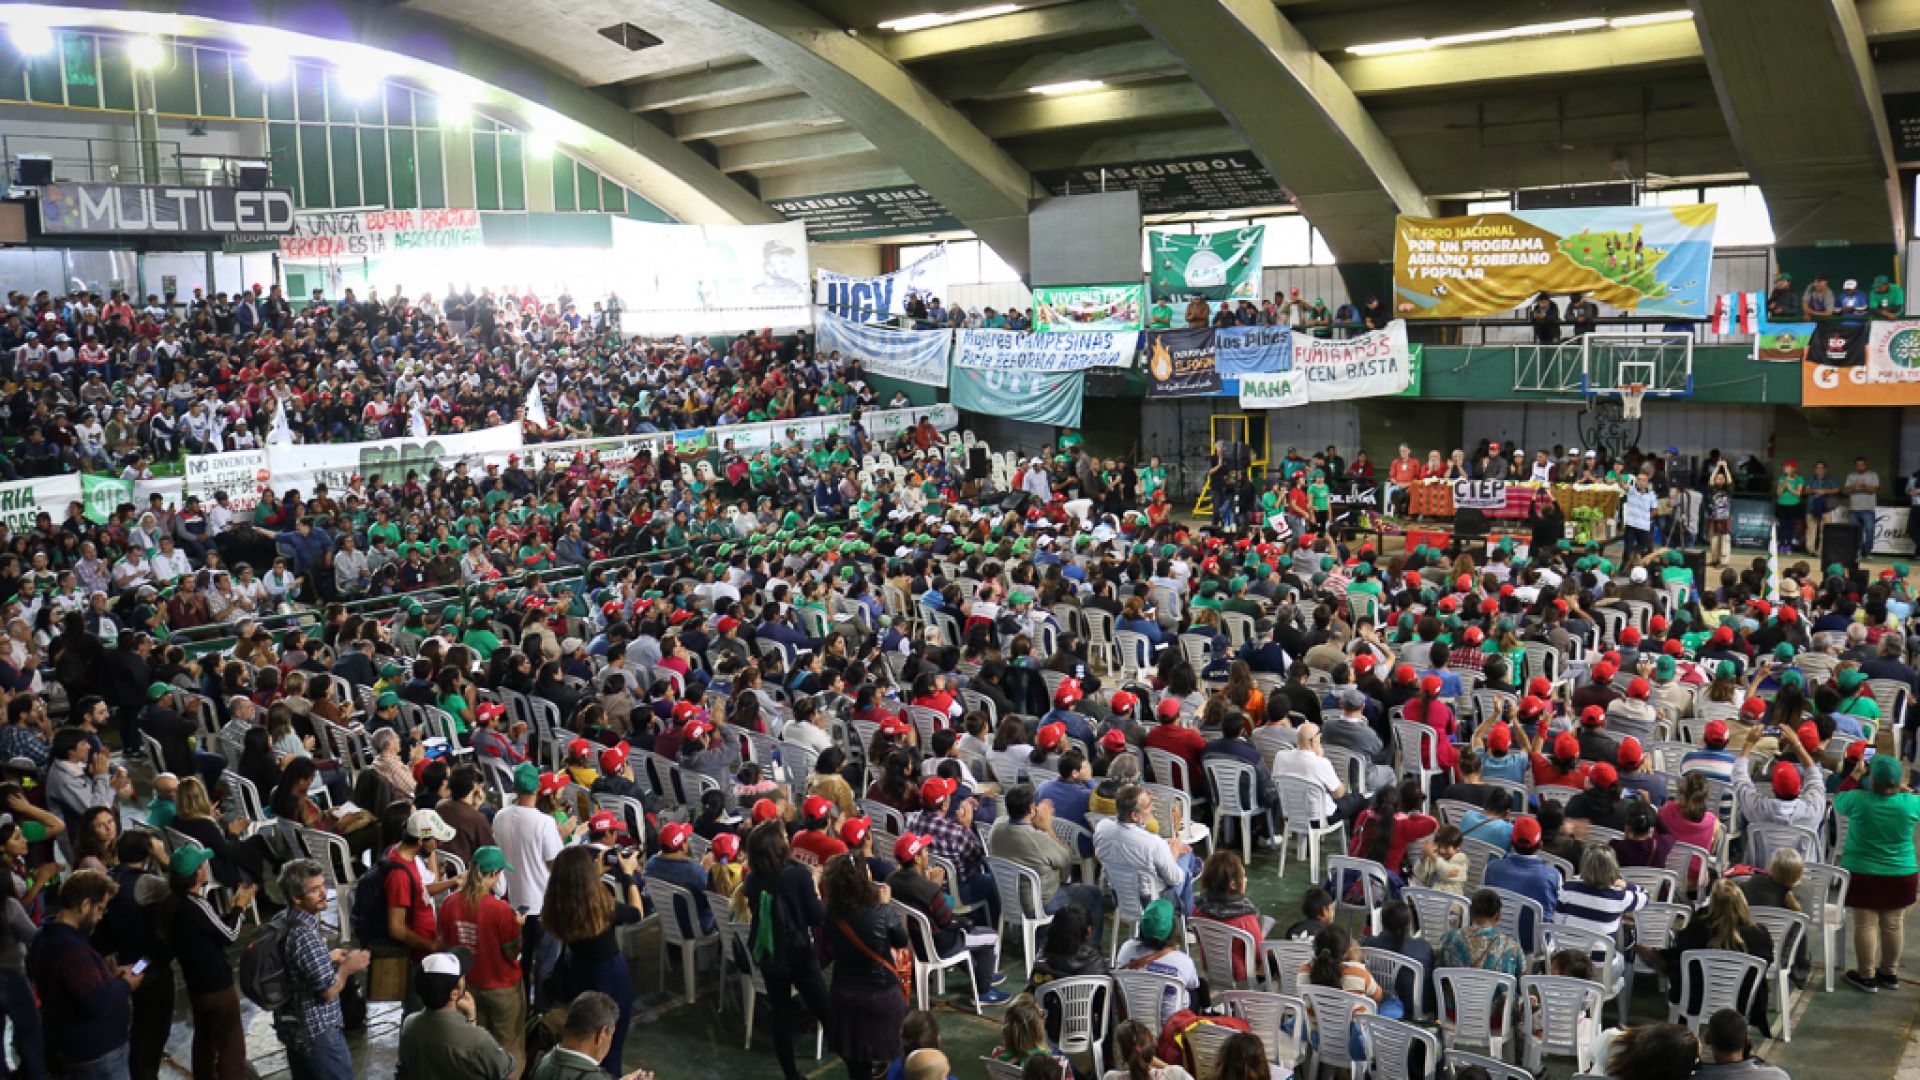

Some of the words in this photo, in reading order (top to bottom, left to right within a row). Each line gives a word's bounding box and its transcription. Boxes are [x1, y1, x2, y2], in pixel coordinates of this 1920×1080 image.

[78, 186, 293, 231] MULTILED
[771, 195, 865, 213] VOLEIBOL
[1422, 228, 1452, 238] FORO
[1456, 225, 1515, 237] NACIONAL
[348, 236, 367, 253] ES
[1408, 239, 1436, 251] POR
[1440, 240, 1459, 251] UN
[1463, 238, 1543, 251] PROGRAMA
[1472, 253, 1550, 265] SOBERANO
[1408, 269, 1418, 279] Y
[1421, 268, 1484, 279] POPULAR
[828, 279, 893, 323] UCV
[1015, 332, 1113, 351] CAMPESINAS
[1346, 357, 1397, 379] BASTA
[1243, 380, 1291, 397] MANA
[189, 460, 209, 474] NO
